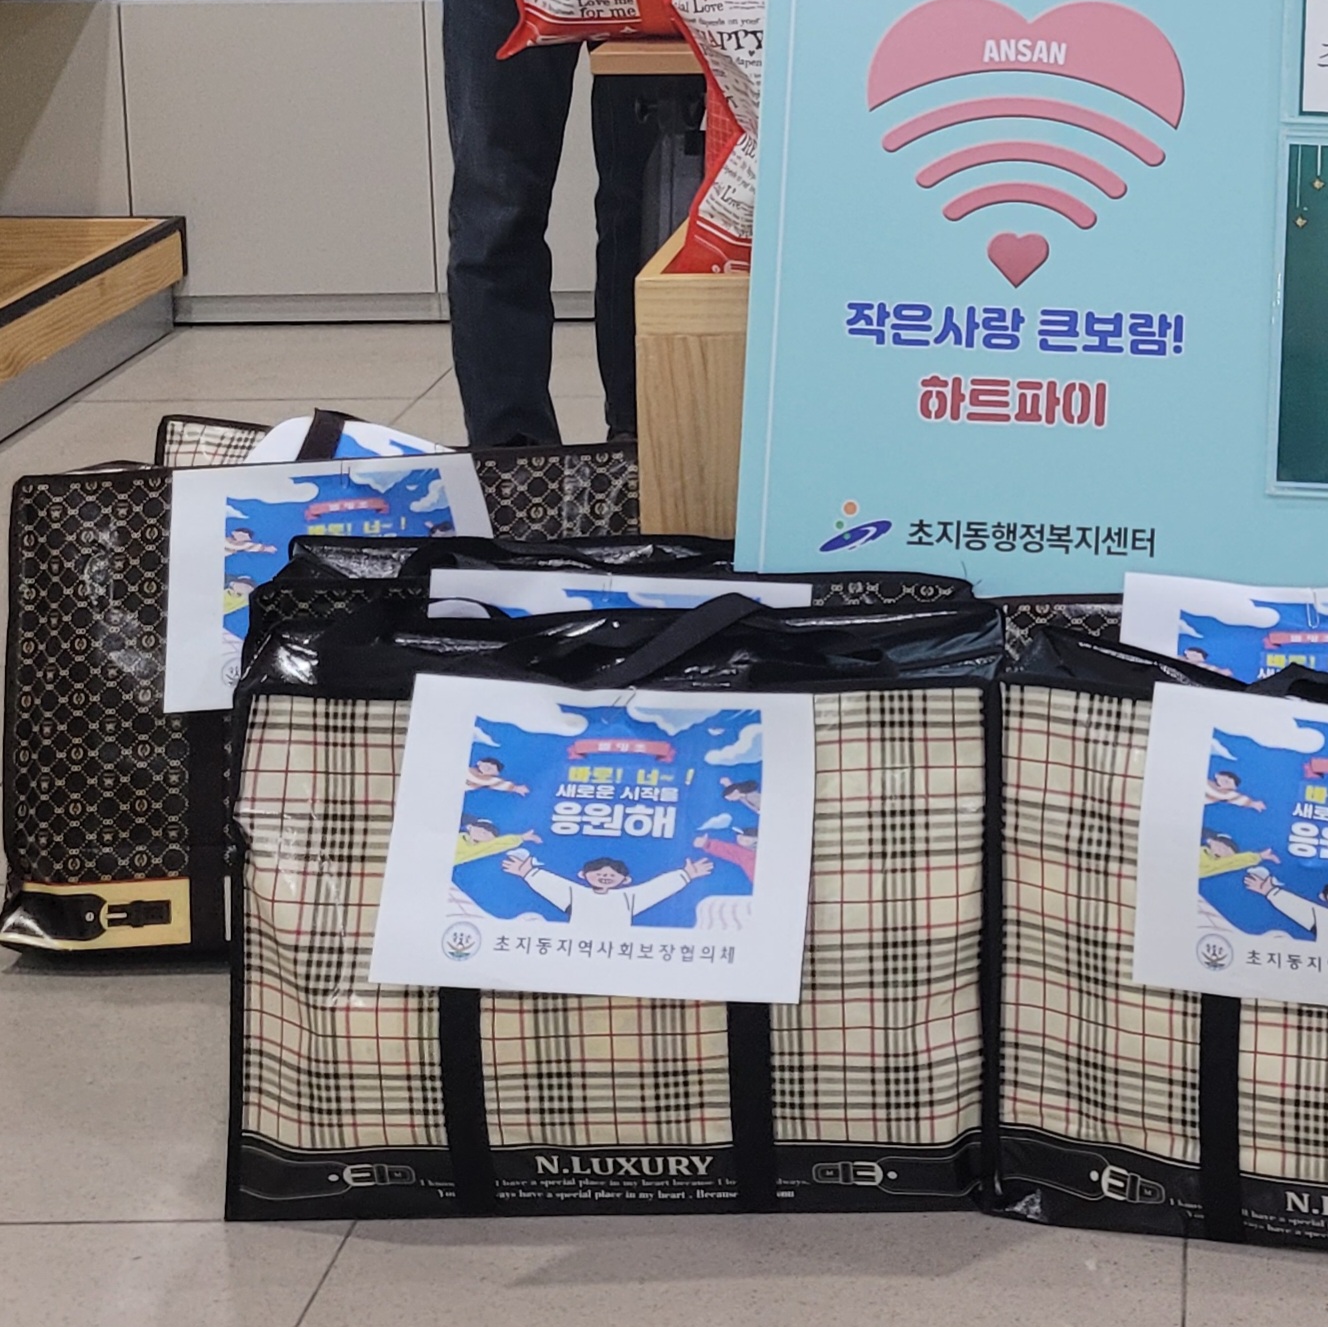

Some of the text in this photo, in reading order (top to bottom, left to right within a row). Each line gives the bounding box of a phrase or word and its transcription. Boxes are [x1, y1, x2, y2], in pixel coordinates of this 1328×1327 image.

[580, 7, 637, 18] for me
[983, 39, 1067, 65] ANSAN
[845, 302, 1184, 356] 작은사랑 큰보람!
[919, 375, 1107, 427] 하트파이
[906, 520, 1157, 557] 초지동행정복지센터
[556, 784, 614, 799] 새로운
[551, 803, 677, 839] 응원해
[493, 935, 735, 963] 초지동지역사회보장협의체
[534, 1156, 713, 1175] N.LUXURY
[539, 1179, 576, 1188] special
[519, 1189, 738, 1201] have special place in my heart Because
[1289, 1216, 1325, 1228] special
